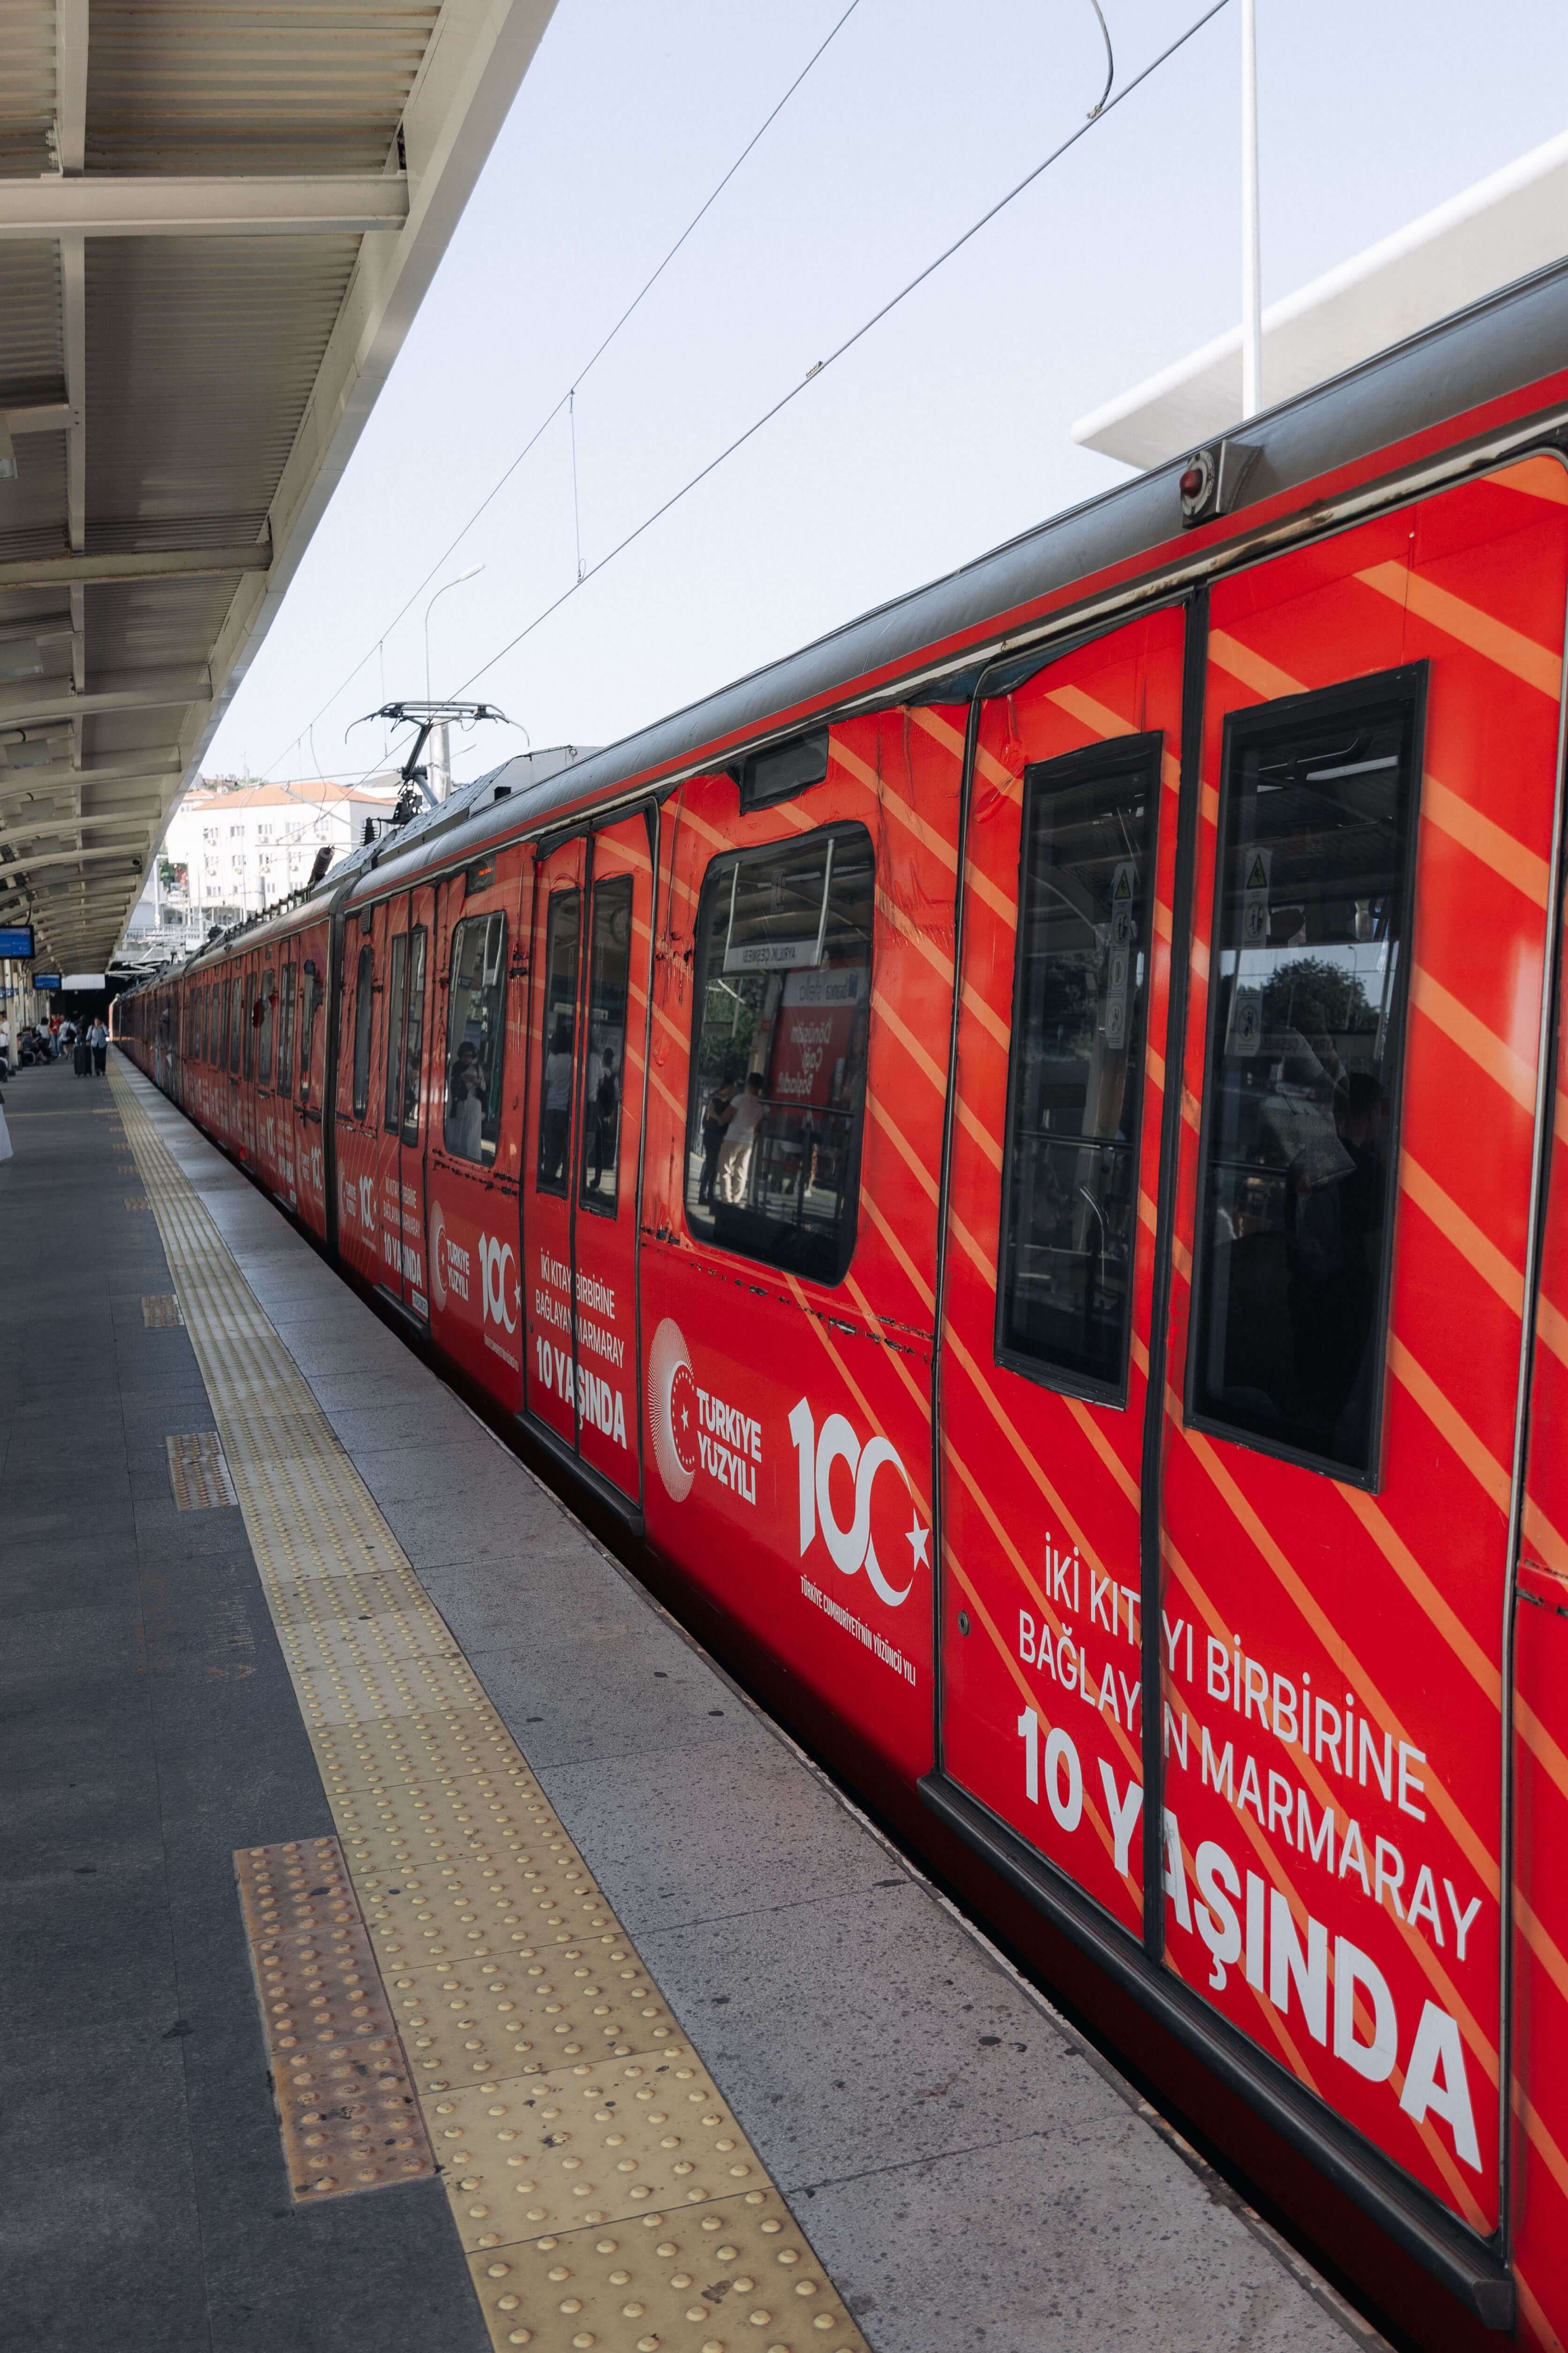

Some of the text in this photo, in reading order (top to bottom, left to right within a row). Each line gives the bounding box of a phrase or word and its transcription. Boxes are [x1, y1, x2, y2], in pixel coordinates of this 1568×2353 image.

[535, 1288, 573, 1335] BAĞLAYAN
[541, 1247, 615, 1320] İKİ KITAY BİRBİRİNE
[536, 1335, 552, 1389] 10
[554, 1347, 627, 1450] YAŞINDA
[696, 1387, 762, 1463] TÜRKİYE
[697, 1430, 756, 1506] YÜZYILI
[800, 1573, 916, 1687] TÜRKİYE CUMHURİYETİ'NİN YÜZÜNCÜ YILI
[1045, 1532, 1427, 1823] İKİ KITYI BİRBİRİNE
[1019, 1609, 1483, 1961] BAĞLAYN MARMARAY
[1017, 1705, 1483, 2174] 10 YAŞINDA
